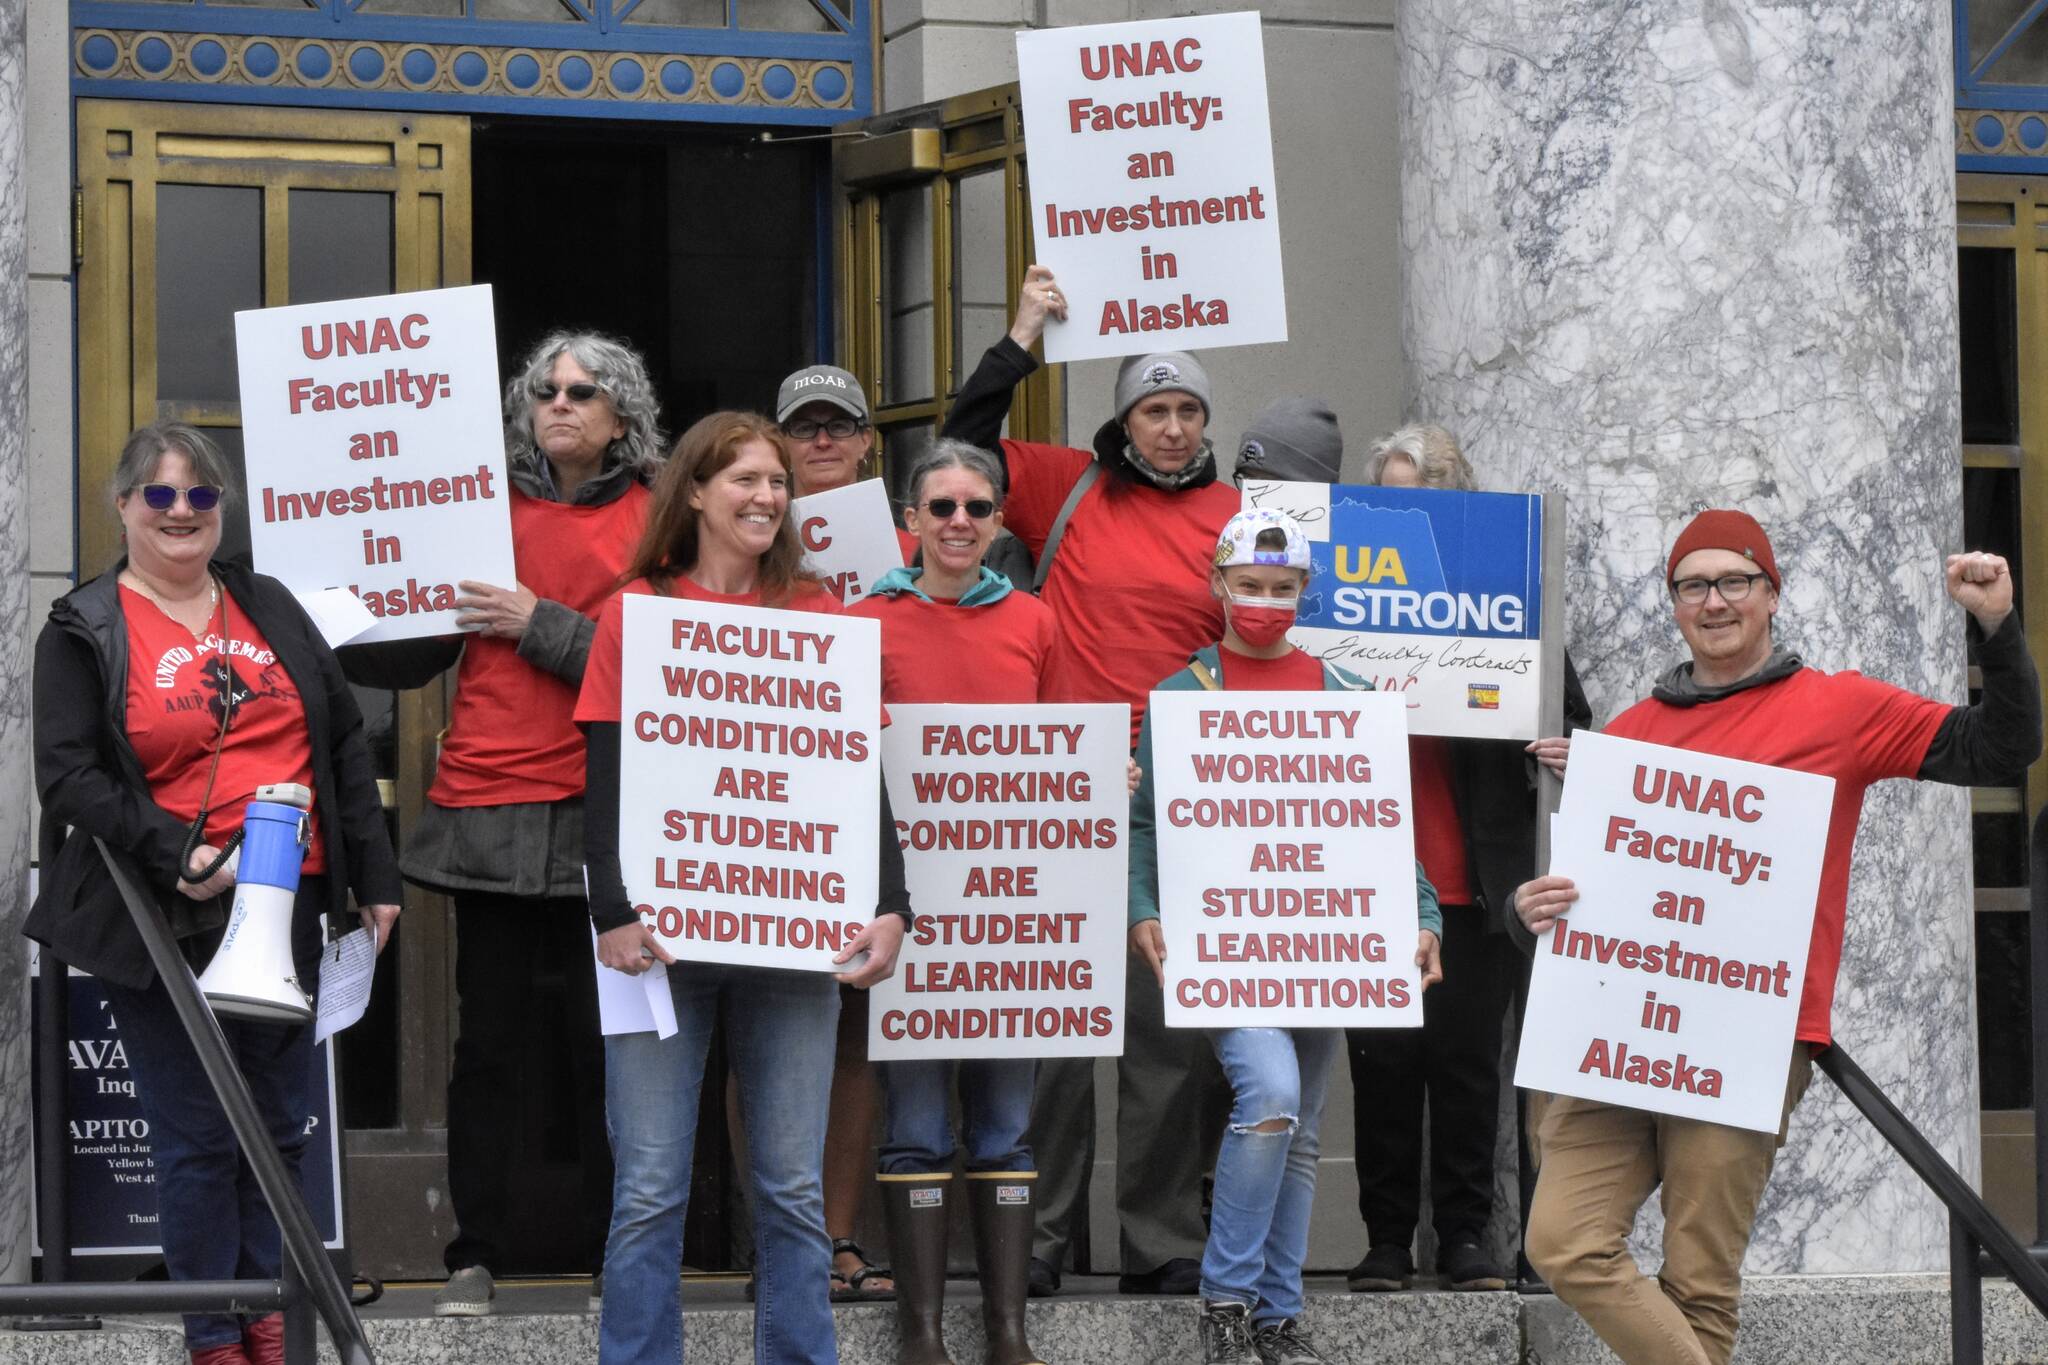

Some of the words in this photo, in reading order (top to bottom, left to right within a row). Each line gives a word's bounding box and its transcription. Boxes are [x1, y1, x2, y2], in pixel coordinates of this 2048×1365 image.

[1080, 38, 1202, 80] UNAC
[1069, 91, 1223, 133] Faculty:
[1128, 151, 1174, 179] an
[1046, 187, 1265, 238] Investment
[1141, 246, 1177, 280] in
[1099, 294, 1229, 335] Alaska
[302, 314, 430, 360] UNAC
[288, 368, 451, 415] Faculty:
[794, 375, 846, 390] MOAB
[349, 430, 398, 460] an
[262, 465, 495, 522] Investment
[363, 529, 401, 565] in
[1334, 545, 1408, 585] UA
[325, 579, 456, 617] aska
[1333, 587, 1523, 632] STRONG
[672, 619, 835, 664] FACULTY
[1321, 635, 1433, 677] Faculty
[1438, 639, 1533, 674] Contracts
[662, 665, 842, 713] WORKING
[634, 711, 869, 763] CONDITIONS
[922, 724, 1085, 755] FACULTY
[1199, 710, 1361, 739] FACULTY
[713, 767, 789, 803] ARE
[1191, 754, 1372, 783] WORKING
[912, 772, 1091, 803] WORKING
[1632, 764, 1765, 823] UNAC
[1167, 798, 1401, 828] CONDITIONS
[663, 810, 839, 855] STUDENT
[1604, 815, 1772, 885] Faculty:
[1250, 843, 1325, 872] ARE
[655, 857, 846, 904] LEARNING
[963, 867, 1038, 897] ARE
[1202, 888, 1376, 917] STUDENT
[1652, 890, 1705, 925] an
[913, 913, 1087, 945] STUDENT
[1197, 933, 1387, 962] LEARNING
[1551, 918, 1792, 998] Investment
[905, 960, 1093, 993] LEARNING
[1176, 978, 1411, 1008] CONDITIONS
[881, 1006, 1113, 1040] CONDITIONS
[1641, 991, 1681, 1034] in
[69, 1040, 129, 1069] AVA
[1578, 1038, 1723, 1098] Alaska
[97, 1077, 136, 1098] Inq
[70, 1119, 150, 1139] APITO
[74, 1144, 117, 1154] Located
[119, 1144, 130, 1153] in
[107, 1159, 145, 1168] Yellow
[114, 1174, 142, 1183] West
[143, 1174, 156, 1184] 4t
